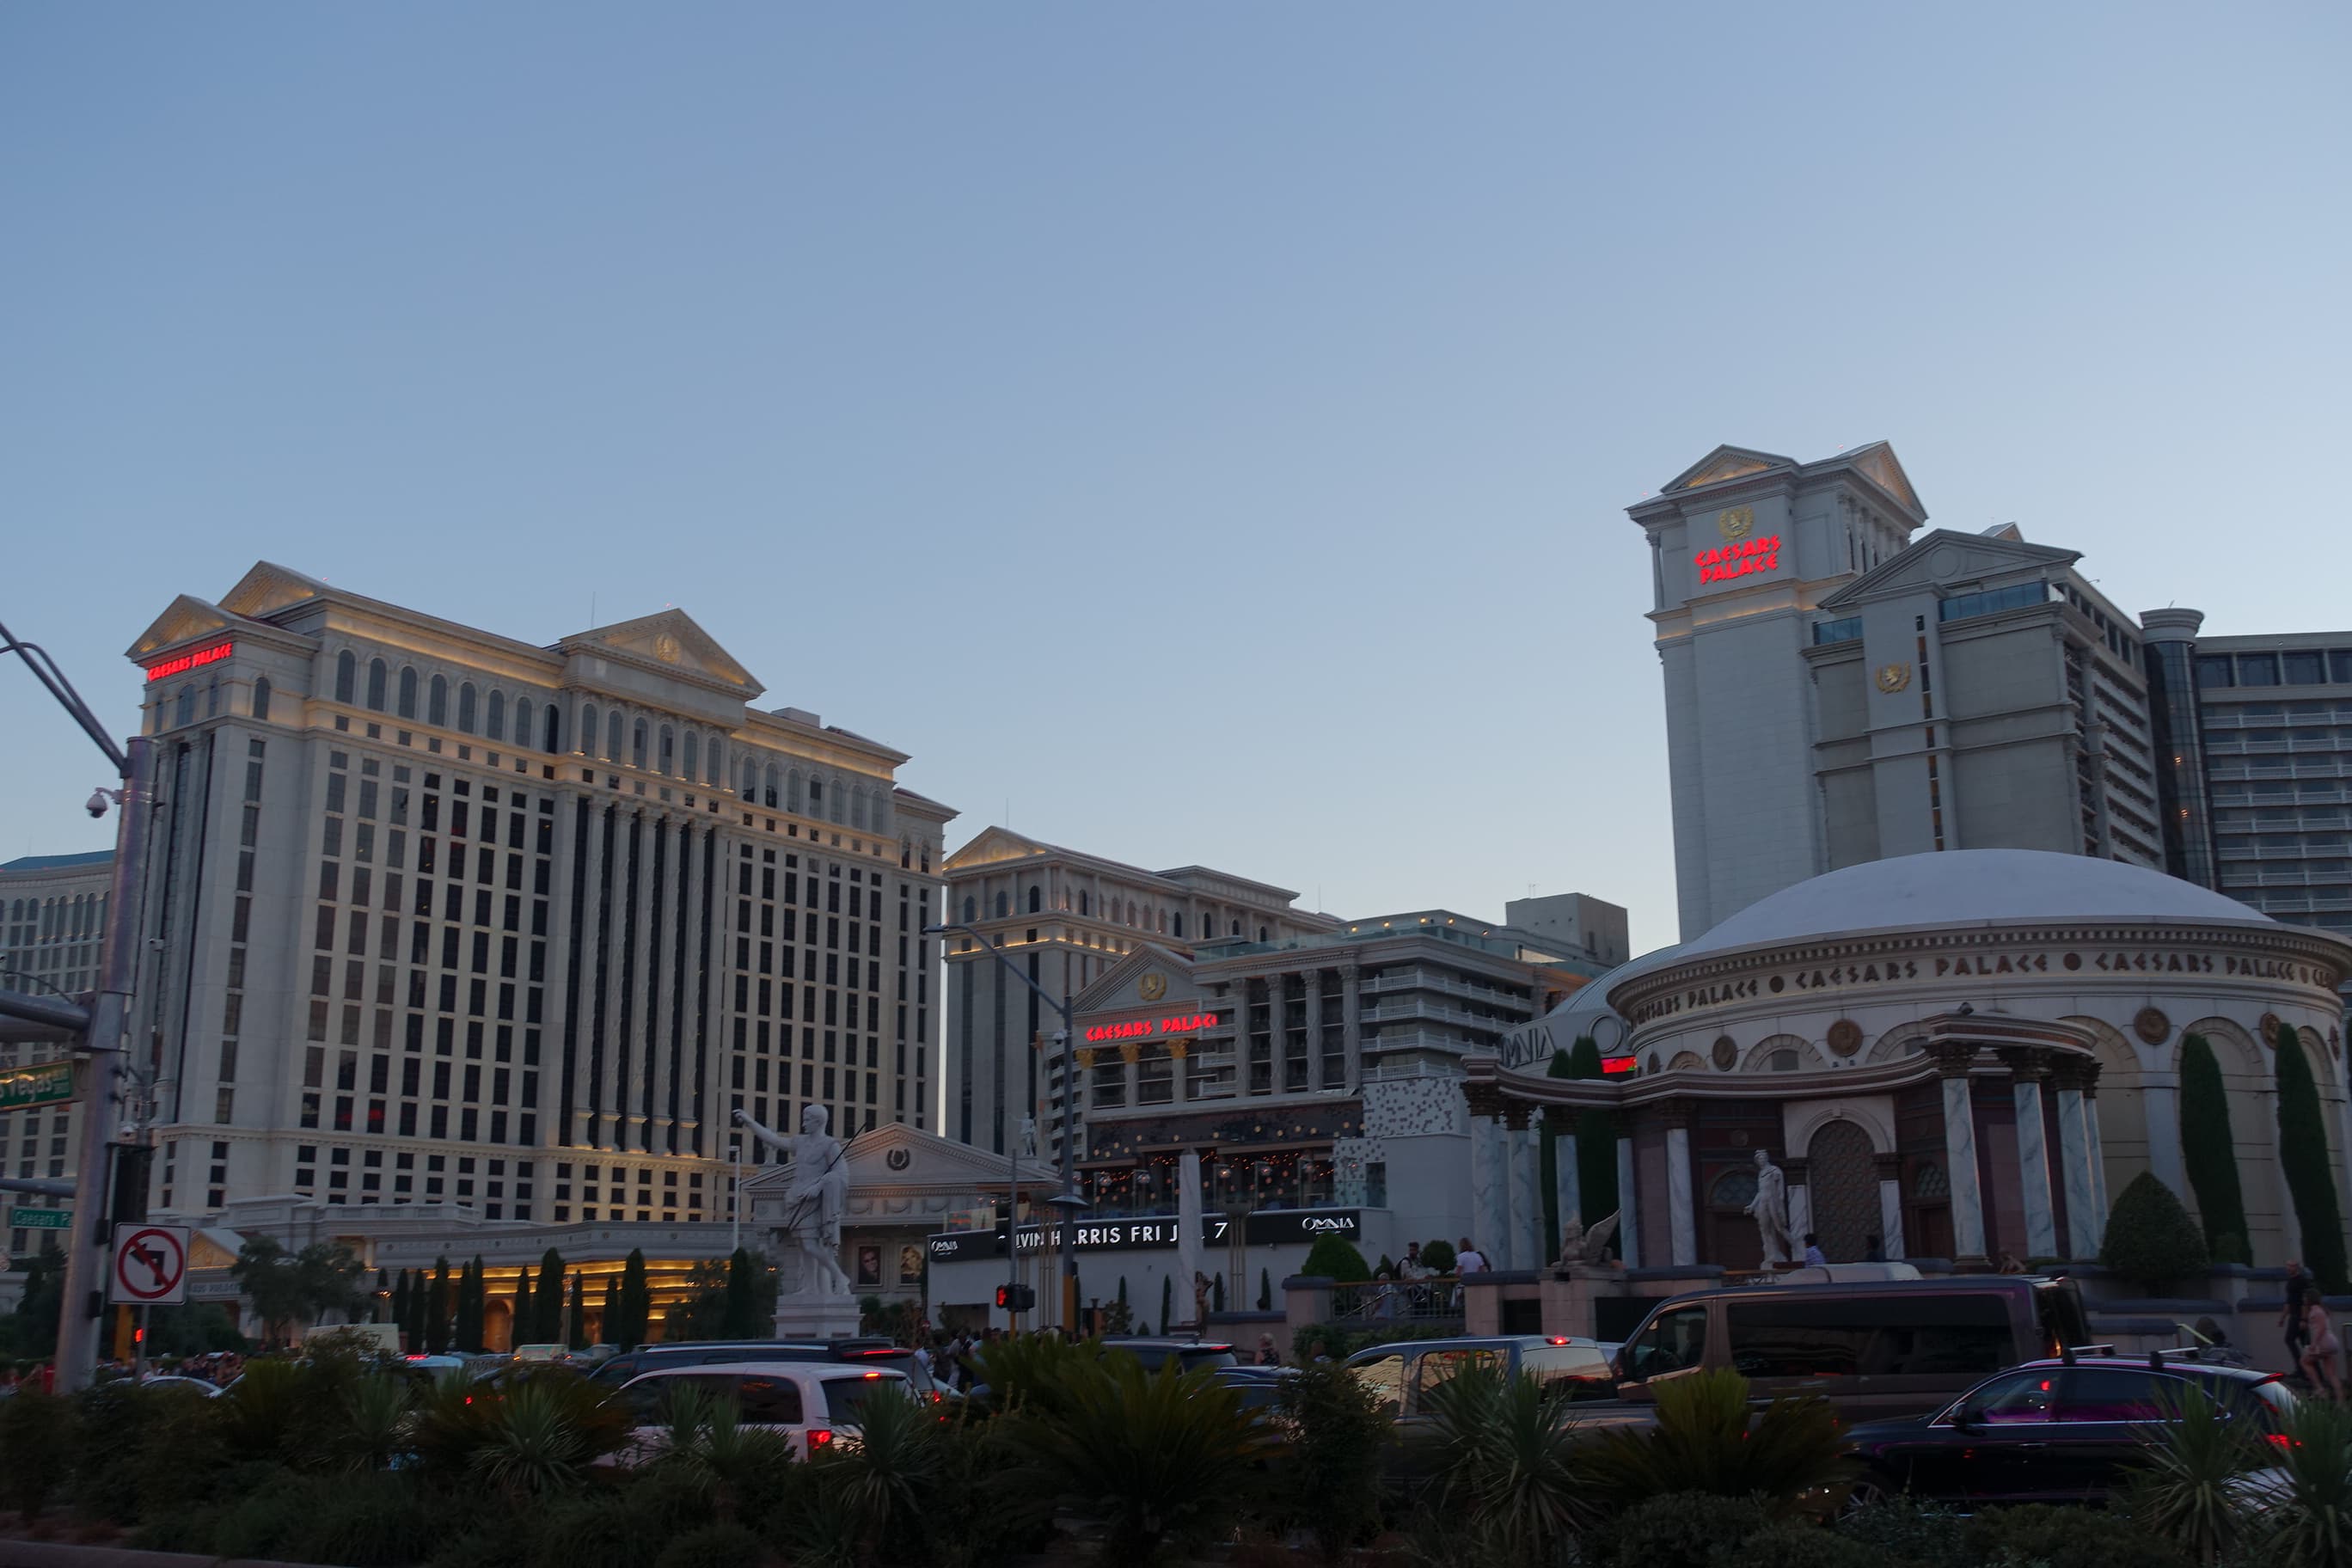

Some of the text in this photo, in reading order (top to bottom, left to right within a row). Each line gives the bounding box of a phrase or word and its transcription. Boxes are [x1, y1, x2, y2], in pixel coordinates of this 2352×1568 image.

[1694, 534, 1782, 567] CAESARS
[1700, 553, 1779, 585] PALACE
[147, 643, 233, 682] CAESARS PALACE
[1687, 978, 1758, 1009] PALACE
[1796, 960, 1918, 989] CAESARS
[1936, 953, 2048, 977] PALACE
[2095, 952, 2214, 973] CAESARS
[2225, 955, 2295, 981] PALACE
[1086, 1020, 1153, 1043] CAESARS
[14, 1210, 56, 1227] Caesars
[1301, 1216, 1356, 1231] OMNIA
[1050, 1227, 1121, 1246] HRRIS
[1130, 1224, 1161, 1243] FRI
[1214, 1222, 1229, 1239] 7
